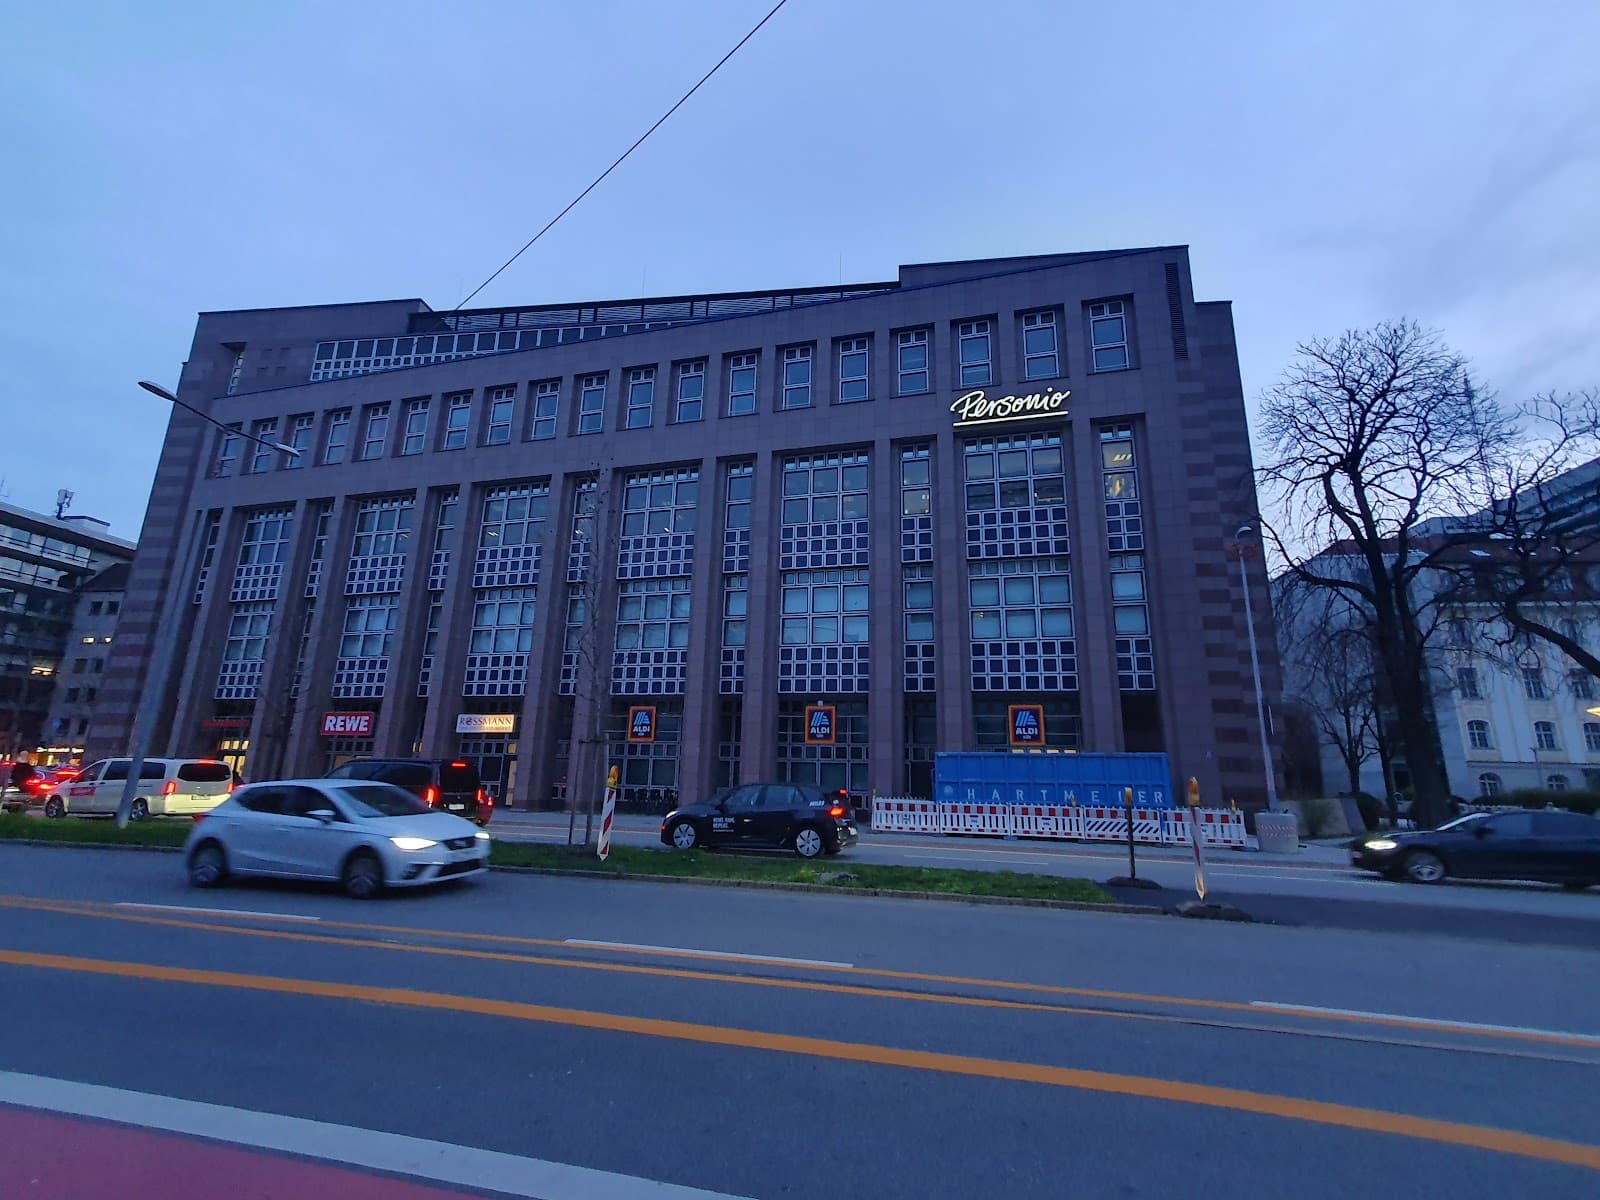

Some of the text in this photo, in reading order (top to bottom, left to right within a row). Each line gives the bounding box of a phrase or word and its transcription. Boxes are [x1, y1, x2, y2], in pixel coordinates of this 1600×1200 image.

[950, 387, 1071, 420] Personio
[324, 715, 370, 732] REWE
[460, 716, 512, 726] ROSSMANN
[810, 726, 830, 734] ALDI
[1015, 727, 1038, 735] ALDI
[967, 788, 1164, 804] HARTMEIER
